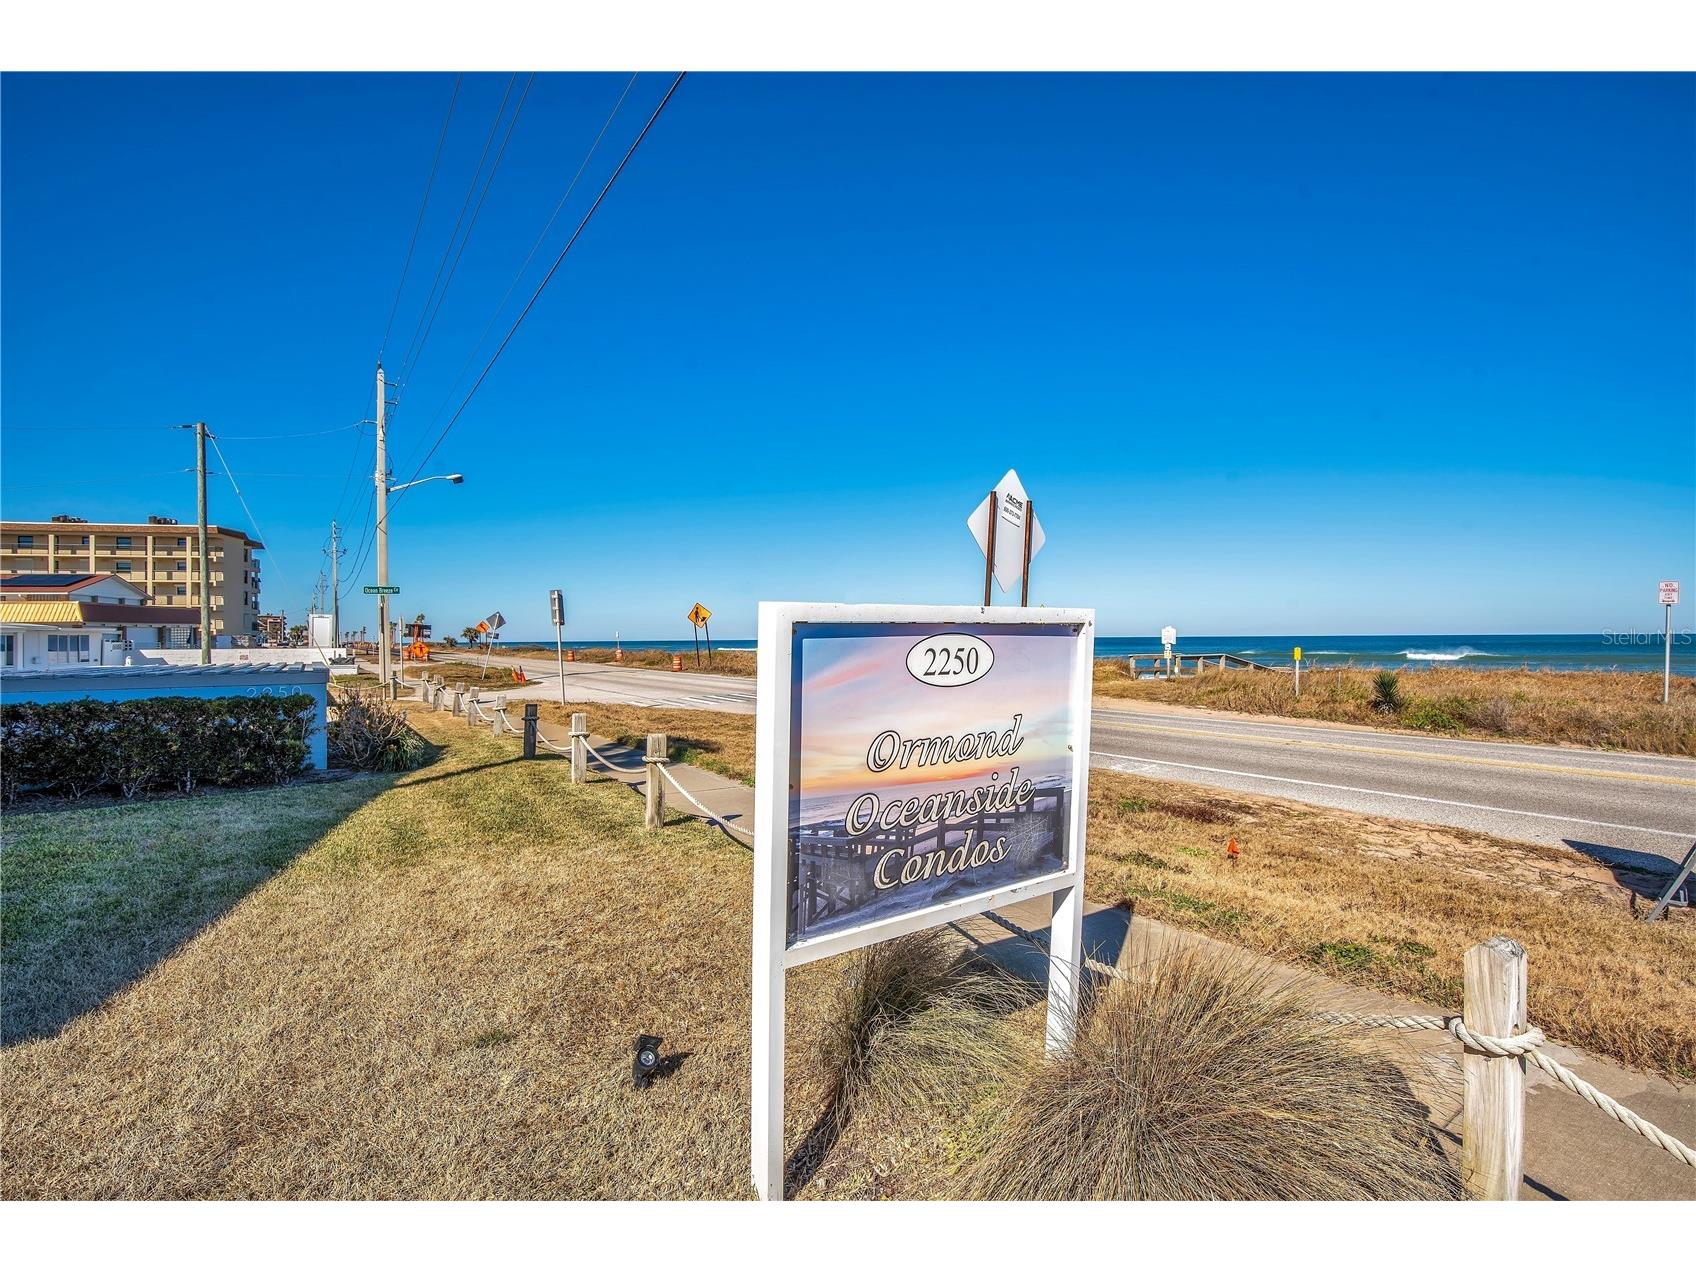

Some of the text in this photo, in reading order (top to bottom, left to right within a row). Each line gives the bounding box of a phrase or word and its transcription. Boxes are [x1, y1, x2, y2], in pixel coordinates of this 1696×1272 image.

[924, 647, 979, 676] 2250
[867, 714, 1024, 772] Ormond
[845, 767, 1036, 836] Oceanside
[873, 829, 1012, 890] Condos
